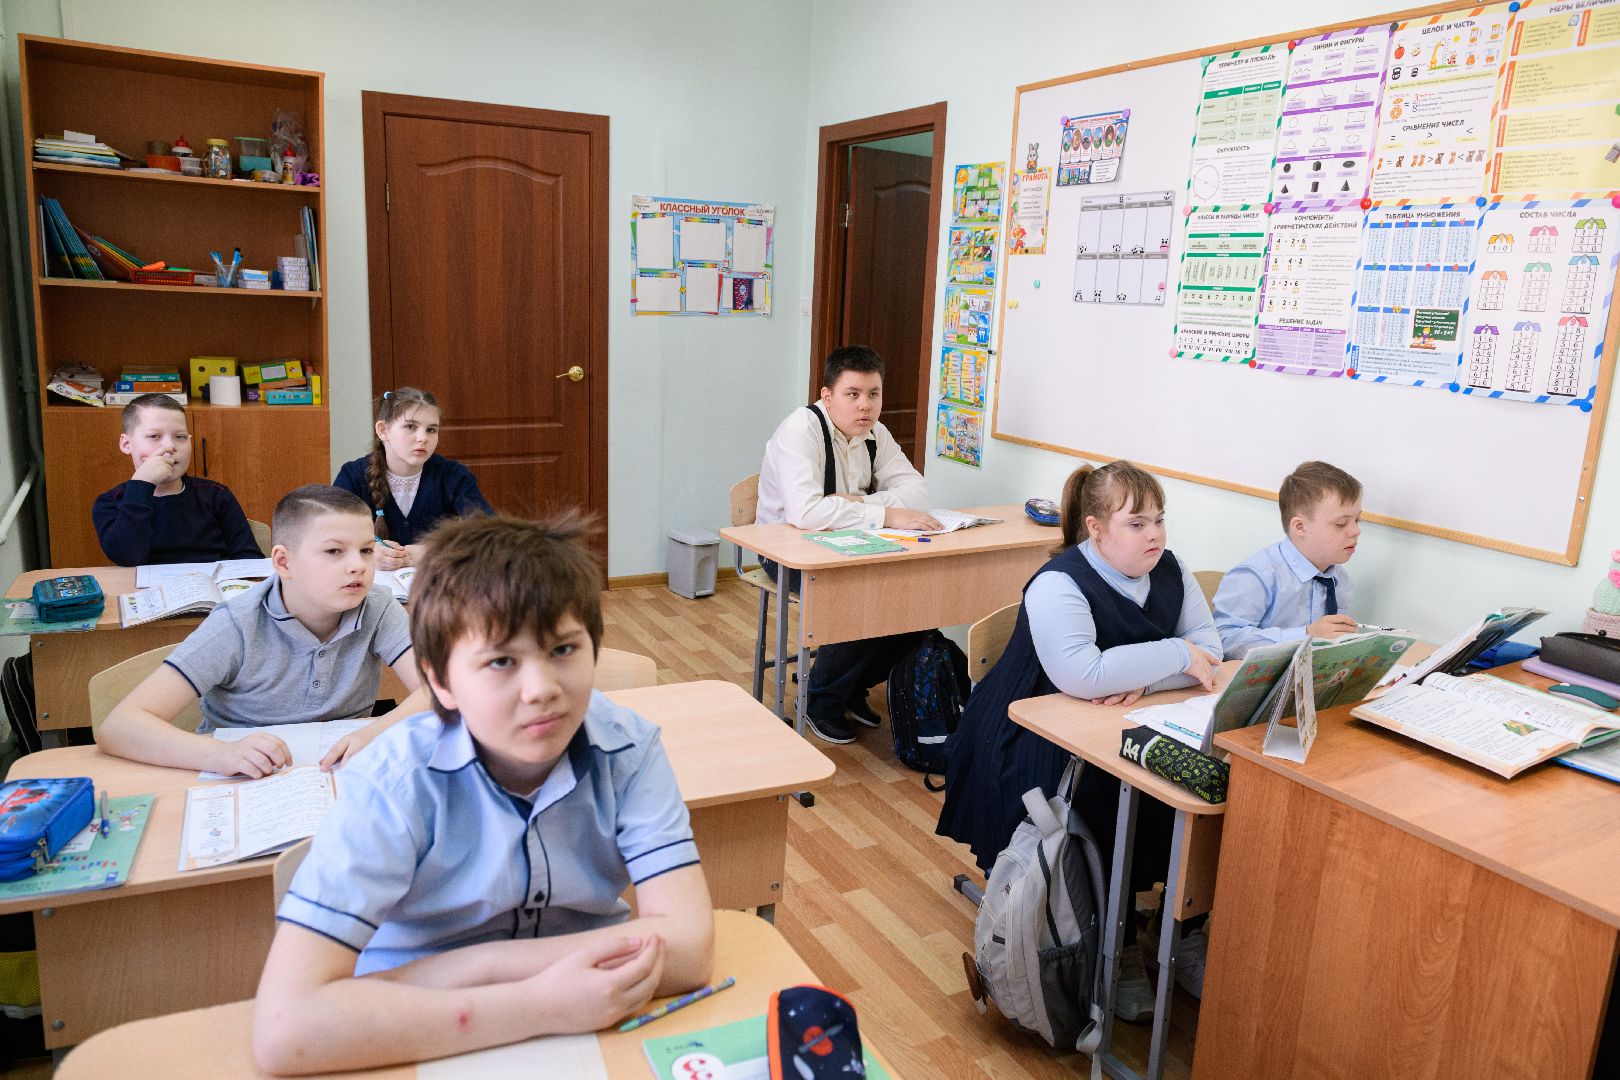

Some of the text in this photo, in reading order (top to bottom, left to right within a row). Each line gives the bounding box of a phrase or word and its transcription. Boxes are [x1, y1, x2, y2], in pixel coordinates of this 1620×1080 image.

[1422, 20, 1475, 35] ЦЕЛОЕ И ЧАСТЬ
[1312, 42, 1332, 52] ЛИНИИ
[1339, 36, 1365, 47] ФИГУРЫ
[1402, 120, 1464, 132] СРАВНЕНИЕ ЧИСЕЛ
[1216, 145, 1250, 154] ОКРУЖНОСТЬ
[1022, 172, 1048, 182] ГРАМОТА
[660, 202, 710, 214] КЛАССНЫЙ
[712, 207, 745, 216] УГОЛОК
